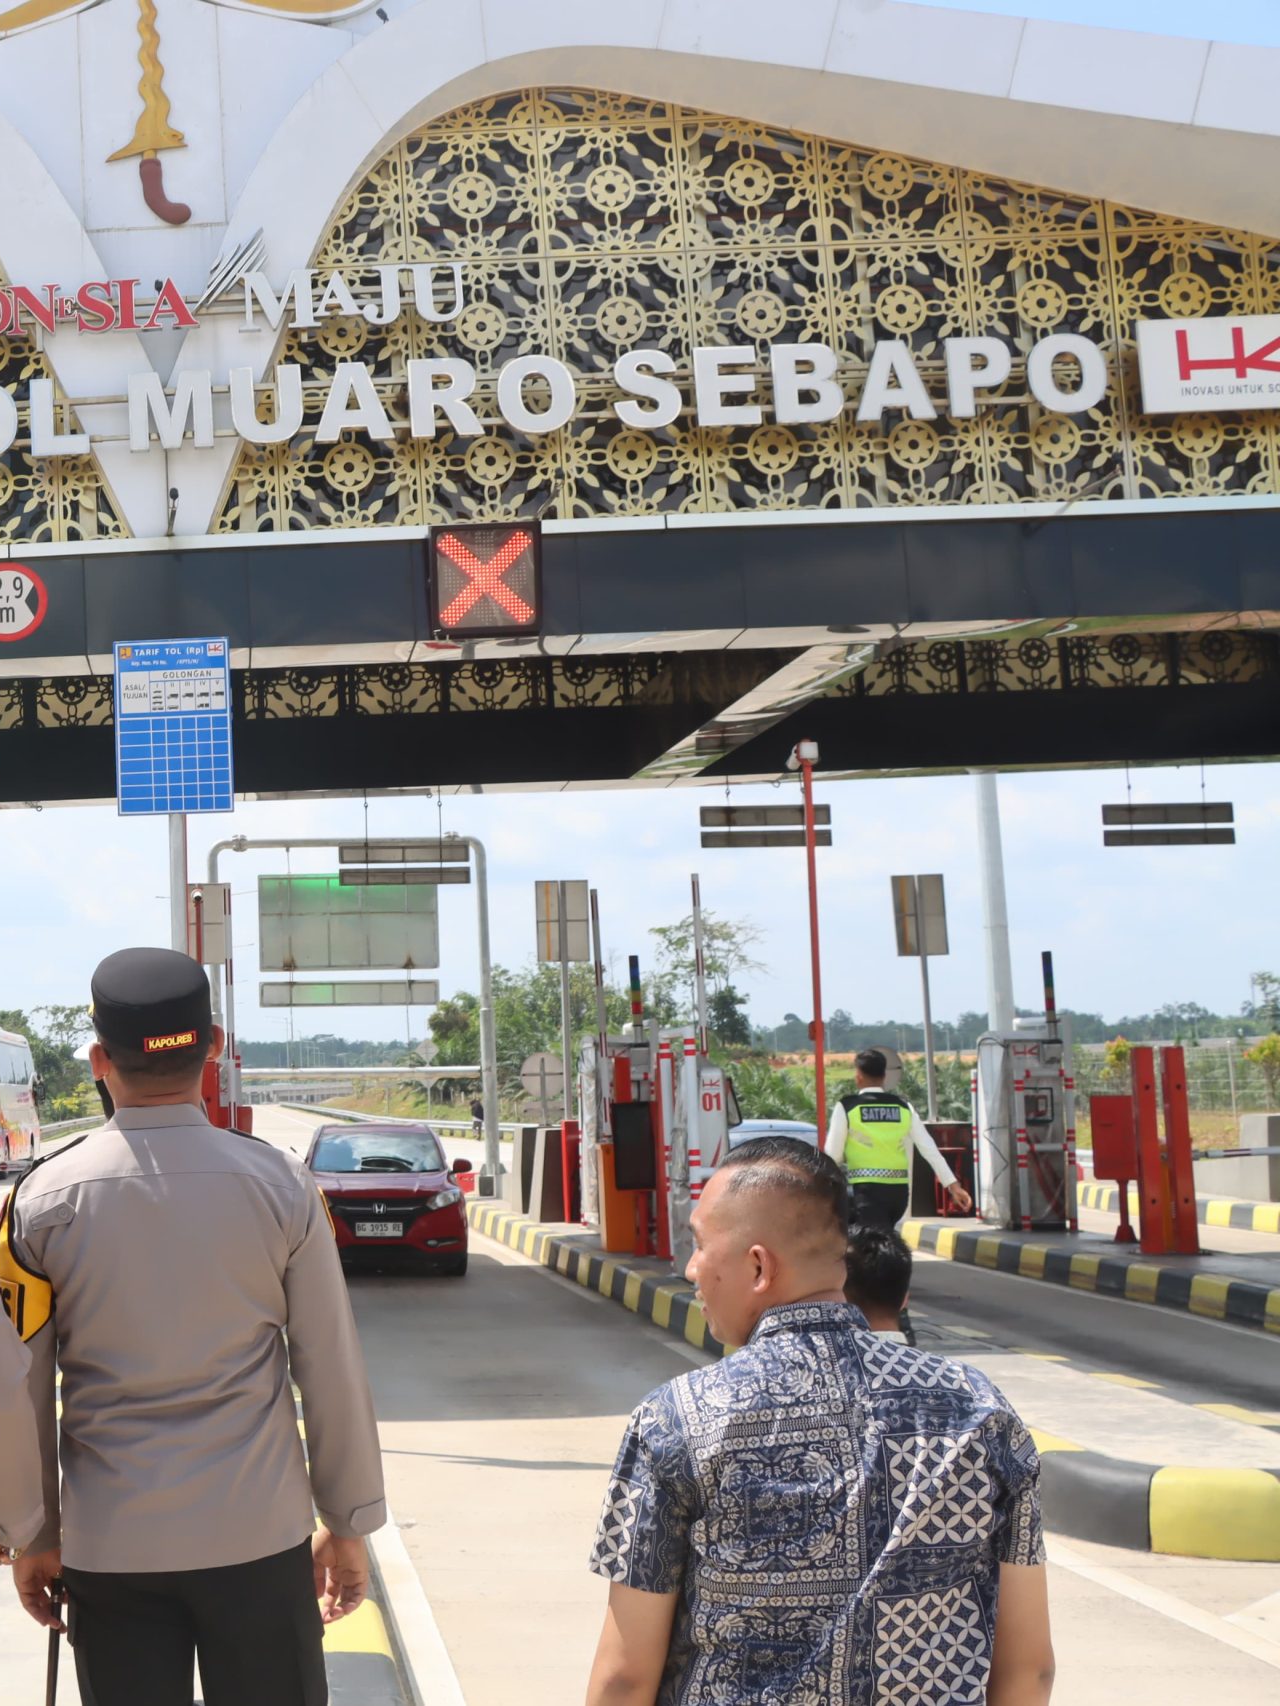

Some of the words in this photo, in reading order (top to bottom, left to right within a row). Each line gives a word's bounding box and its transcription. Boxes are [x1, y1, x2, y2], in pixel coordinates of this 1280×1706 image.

[239, 262, 469, 334] MAJU
[1175, 326, 1280, 380] HK
[127, 354, 577, 453] MUARO
[612, 332, 1108, 429] SEBAPO
[1181, 385, 1224, 397] INOVASI
[1228, 383, 1263, 395] UNTUK
[0, 606, 16, 624] m
[134, 648, 160, 656] TARIF
[165, 647, 181, 655] TOL
[162, 670, 212, 679] GOLONGAN
[149, 1033, 193, 1049] KAPOLRES
[703, 1092, 721, 1112] 01
[862, 1107, 900, 1120] SATPAM
